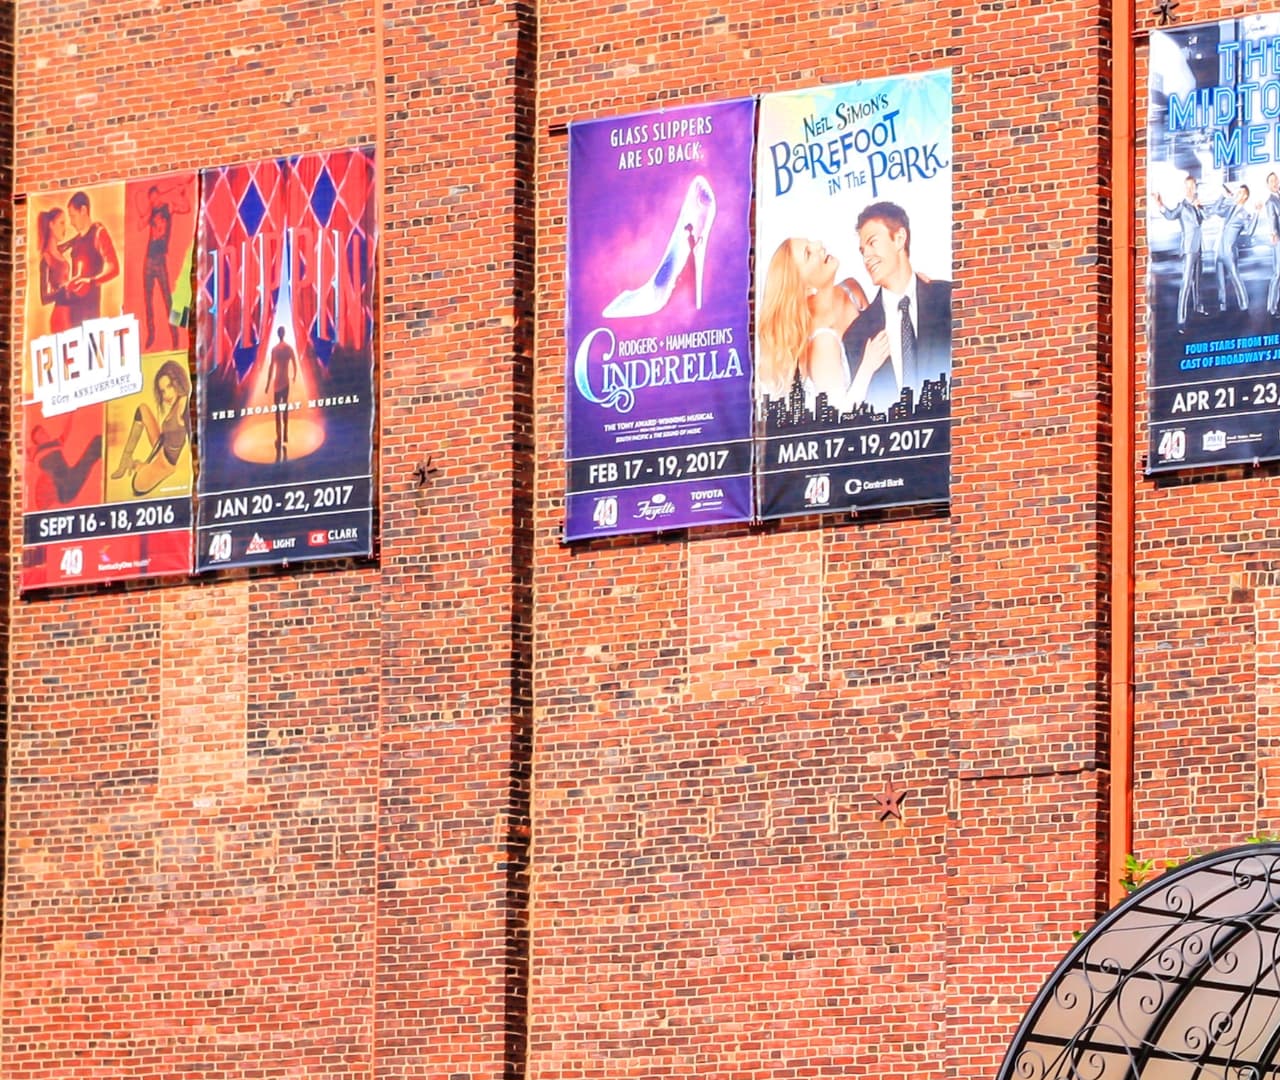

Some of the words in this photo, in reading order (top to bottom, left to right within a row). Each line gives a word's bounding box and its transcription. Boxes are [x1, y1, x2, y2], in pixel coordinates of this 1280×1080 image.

[610, 125, 648, 147] GLASS
[652, 116, 712, 141] SLIPPERS
[618, 150, 642, 170] ARE
[647, 147, 664, 166] SO
[619, 337, 657, 357] RODGERS
[666, 328, 733, 351] HAMMERSTEIN'S
[1185, 342, 1209, 355] FOUR
[1209, 339, 1235, 352] STARS
[1237, 337, 1262, 349] FROM
[1263, 334, 1279, 345] THE
[36, 327, 130, 388] RENT
[574, 327, 744, 413] CINDERELLA
[1180, 358, 1200, 370] CAST
[1202, 357, 1214, 367] OF
[1215, 350, 1271, 366] BROADWAY'S
[212, 409, 235, 420] THE
[241, 401, 301, 417] BROADWAY
[308, 395, 359, 408] MUSICAL
[1171, 390, 1209, 414] APR
[1214, 387, 1234, 408] 21
[604, 423, 616, 432] THE
[617, 421, 634, 430] TONY
[687, 412, 714, 422] MUSICAL
[778, 441, 818, 464] MAR
[824, 438, 844, 458] 17
[860, 434, 885, 456] 19,
[889, 429, 934, 452] 2017
[1158, 430, 1185, 460] 40
[589, 463, 618, 484] FEB
[624, 459, 643, 480] 17
[658, 456, 682, 478] 19,
[686, 450, 729, 473] 2017
[690, 489, 724, 500] TOYOTA
[804, 476, 829, 504] 40
[887, 478, 904, 487] Bank
[214, 498, 248, 519] JAN
[252, 494, 272, 514] 20
[284, 491, 309, 512] 22,
[313, 485, 353, 507] 2017
[593, 497, 618, 526] 40
[39, 515, 75, 537] SEPT
[79, 513, 97, 532] 16
[110, 510, 132, 531] 18,
[136, 505, 174, 526] 2016
[328, 528, 358, 541] CLARK
[209, 533, 232, 560] 40
[272, 538, 296, 549] LIGHT
[60, 549, 83, 576] 40
